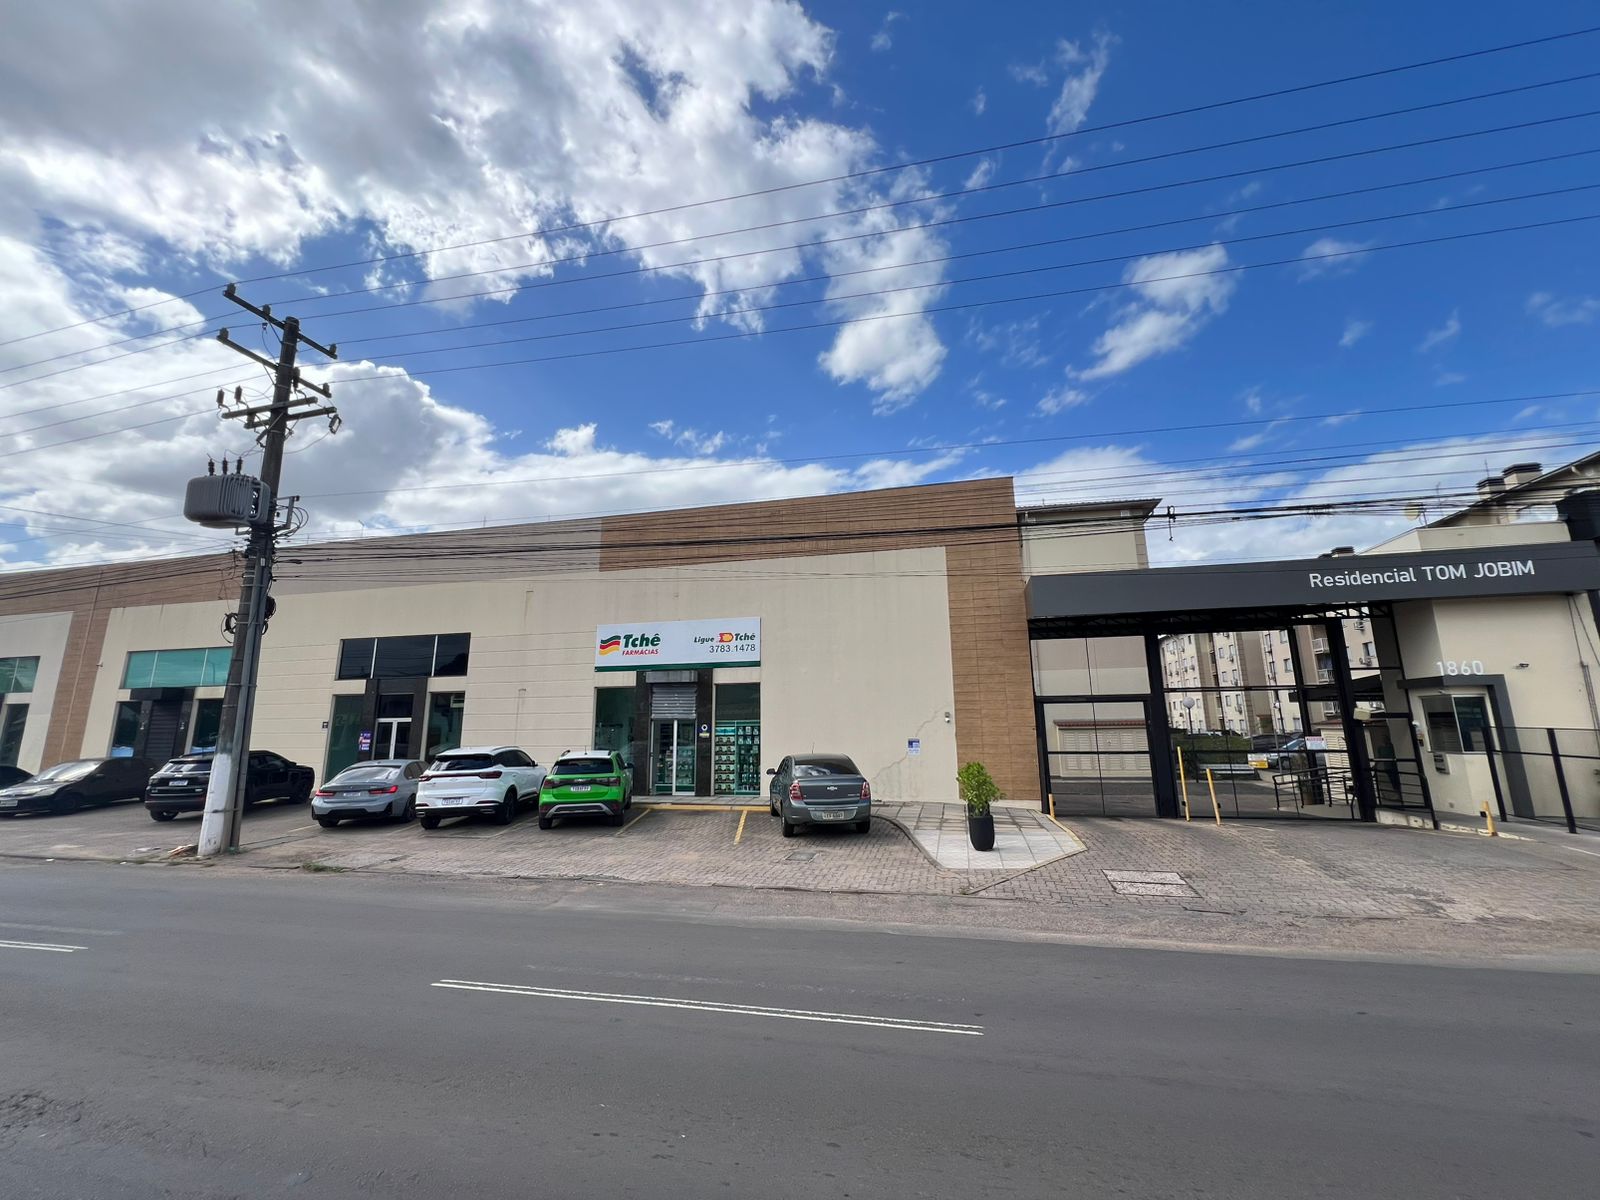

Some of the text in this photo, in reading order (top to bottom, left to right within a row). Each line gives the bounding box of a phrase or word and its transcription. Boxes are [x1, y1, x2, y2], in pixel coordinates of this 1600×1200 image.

[1309, 560, 1535, 588] Residencial TOM JOBIM
[623, 633, 661, 648] Tchê
[693, 636, 715, 645] Ligue
[709, 644, 756, 653] 3783.1478
[1436, 660, 1484, 676] 1860
